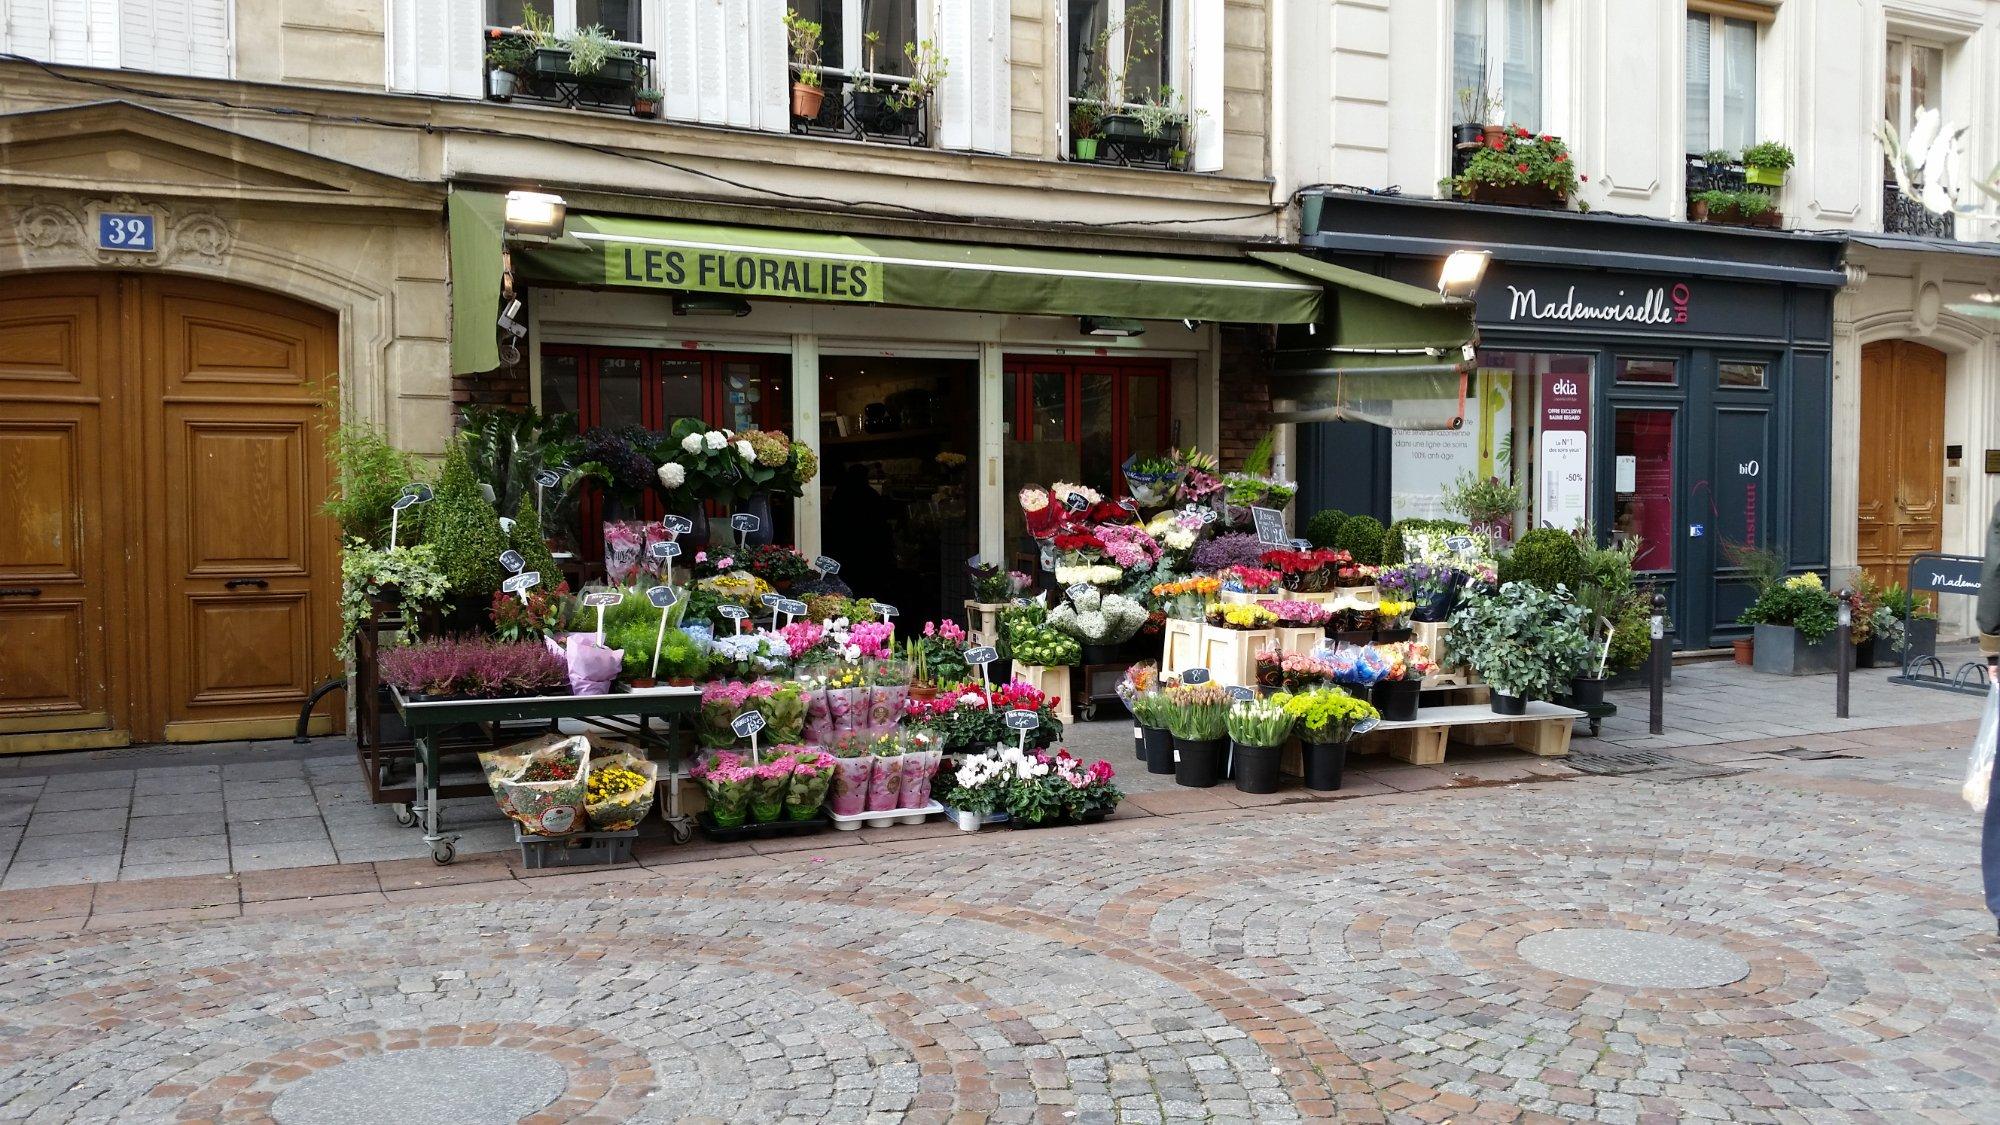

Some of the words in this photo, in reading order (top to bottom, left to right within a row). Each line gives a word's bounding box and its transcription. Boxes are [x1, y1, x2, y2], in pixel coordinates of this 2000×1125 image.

[109, 218, 145, 245] 32
[624, 248, 685, 285] LES
[699, 253, 867, 297] FLORALIES
[1507, 285, 1672, 324] Mademoiselle
[1553, 378, 1577, 395] ekia
[1566, 473, 1583, 482] -50%
